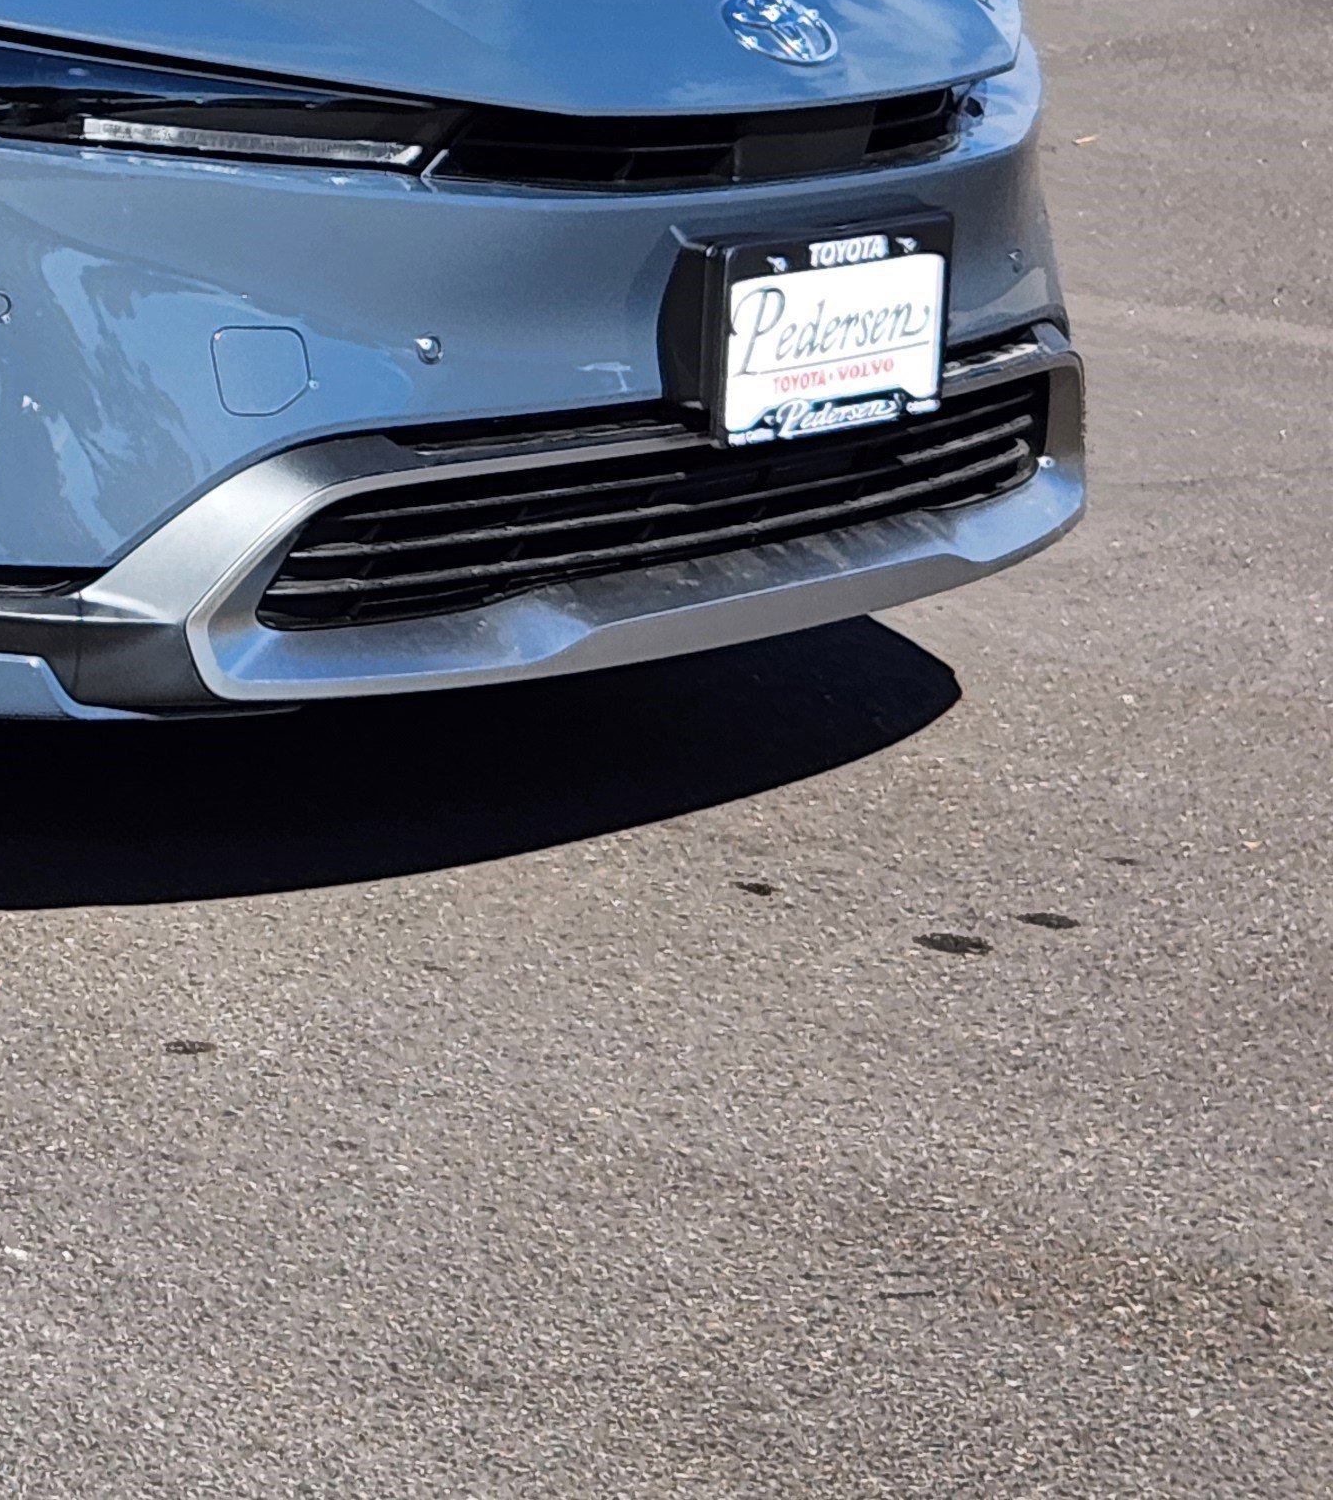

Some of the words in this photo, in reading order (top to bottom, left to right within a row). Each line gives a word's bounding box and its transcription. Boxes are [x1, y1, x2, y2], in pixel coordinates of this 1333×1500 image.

[809, 235, 890, 267] TOYOTA
[732, 286, 930, 376] Pedersen
[773, 369, 827, 394] TOYOTA
[838, 358, 895, 381] VOLVO
[776, 400, 897, 439] Pedersen
